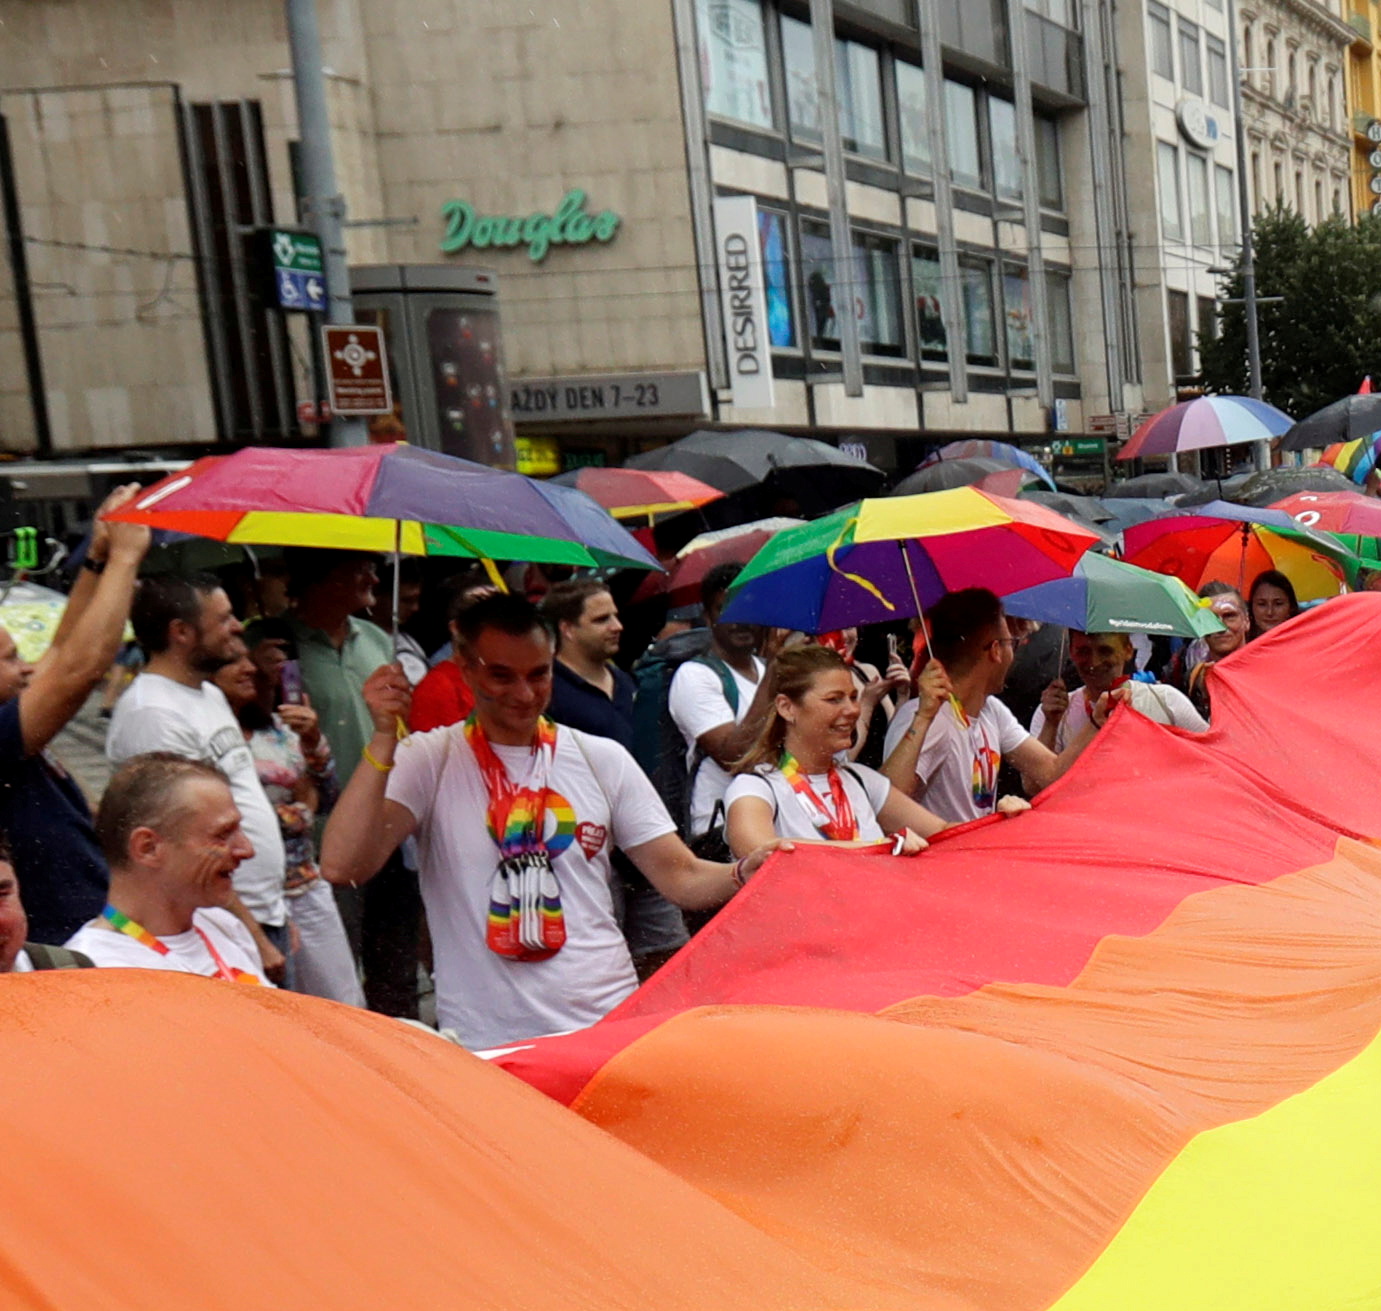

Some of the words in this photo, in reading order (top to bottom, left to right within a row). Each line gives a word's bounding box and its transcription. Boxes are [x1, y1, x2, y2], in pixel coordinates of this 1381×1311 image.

[440, 187, 618, 263] Douglas
[724, 232, 760, 377] DESIRRED
[510, 386, 557, 412] AŽDÝ
[565, 386, 605, 409] DEN
